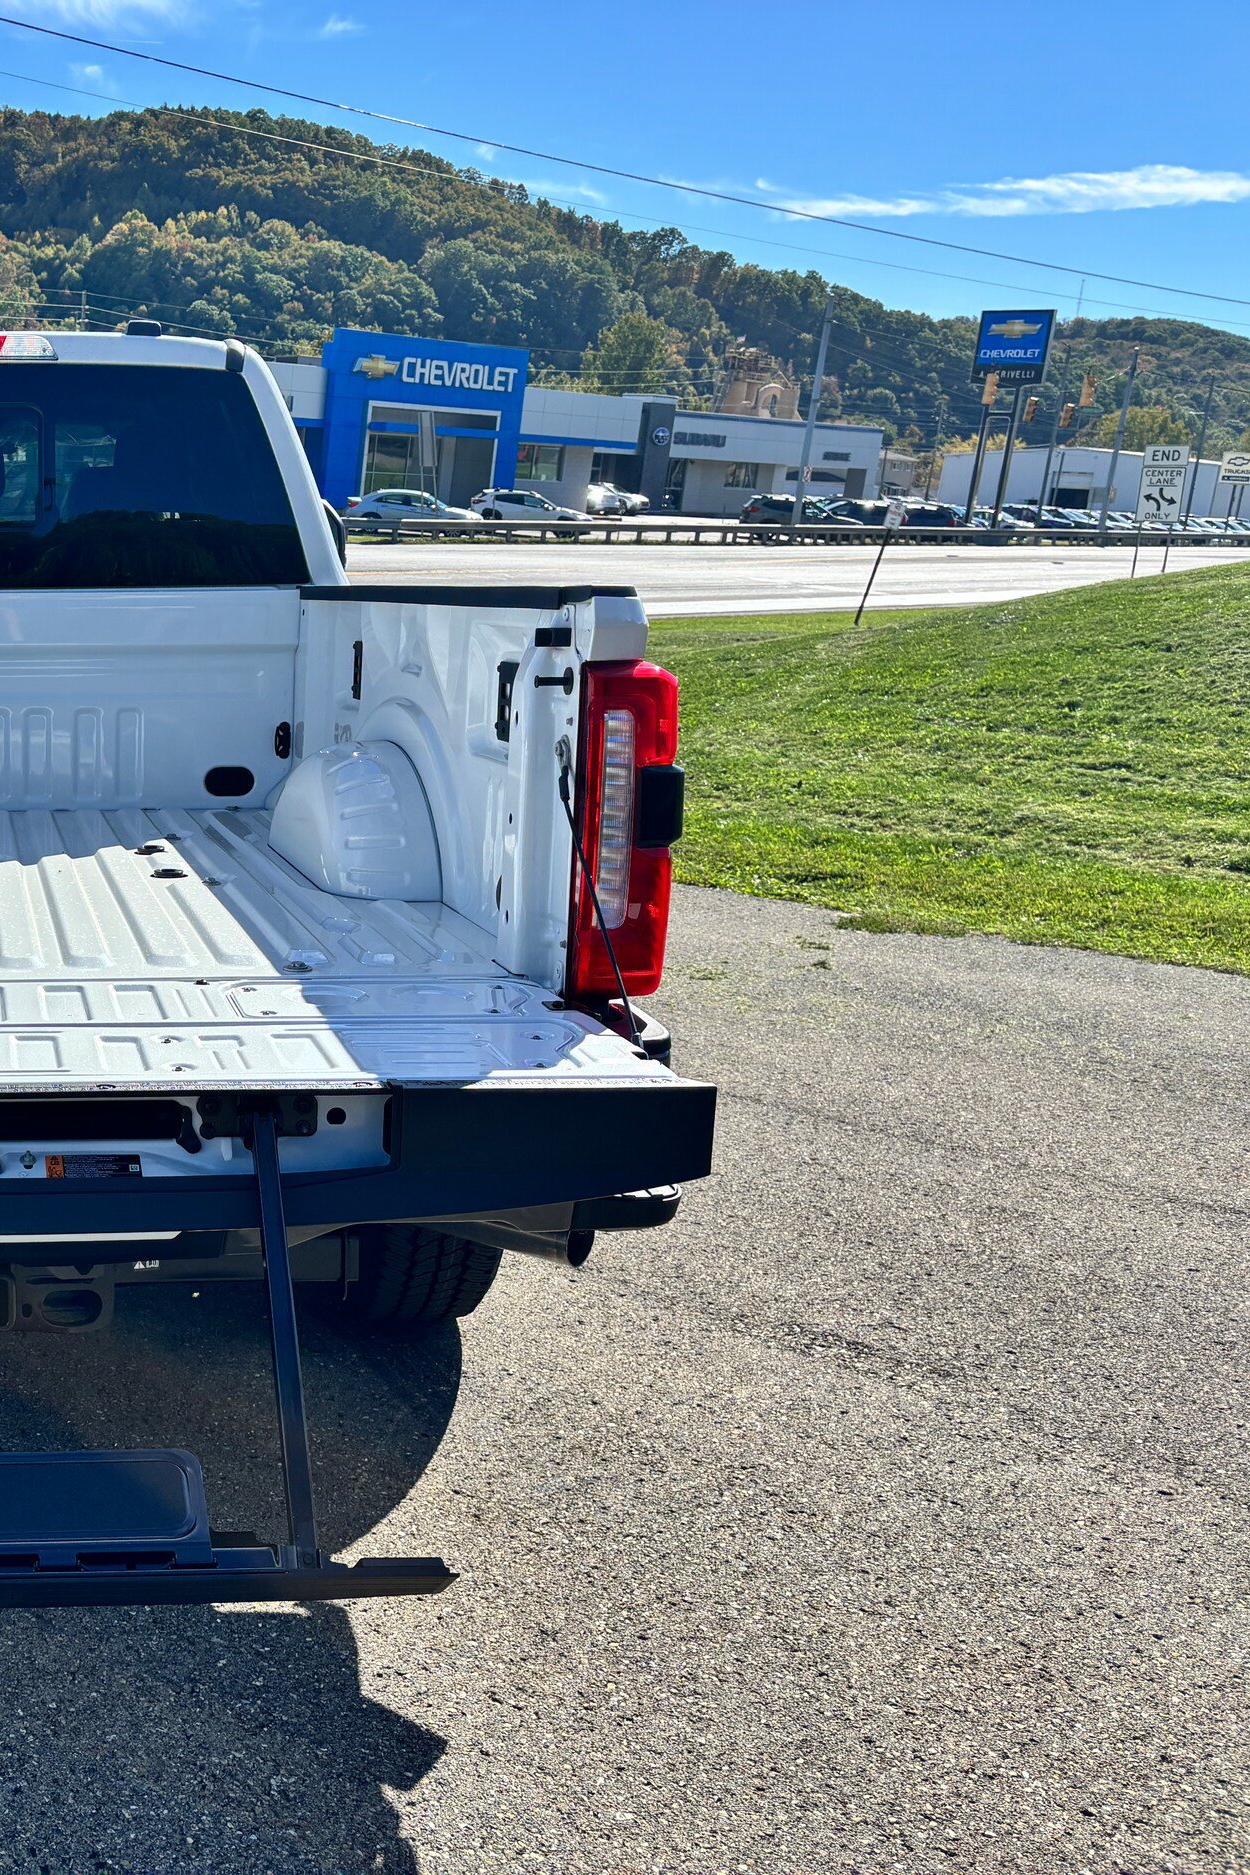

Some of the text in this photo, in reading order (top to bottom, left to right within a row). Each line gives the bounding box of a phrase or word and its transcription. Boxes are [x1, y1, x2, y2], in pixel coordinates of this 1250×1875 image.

[979, 348, 1041, 358] CHEVROLET
[402, 356, 519, 393] CHEVROLET
[1152, 449, 1181, 462] END
[1145, 469, 1183, 477] CENTER
[1149, 477, 1176, 485] LANE
[1144, 512, 1171, 520] ONLY
